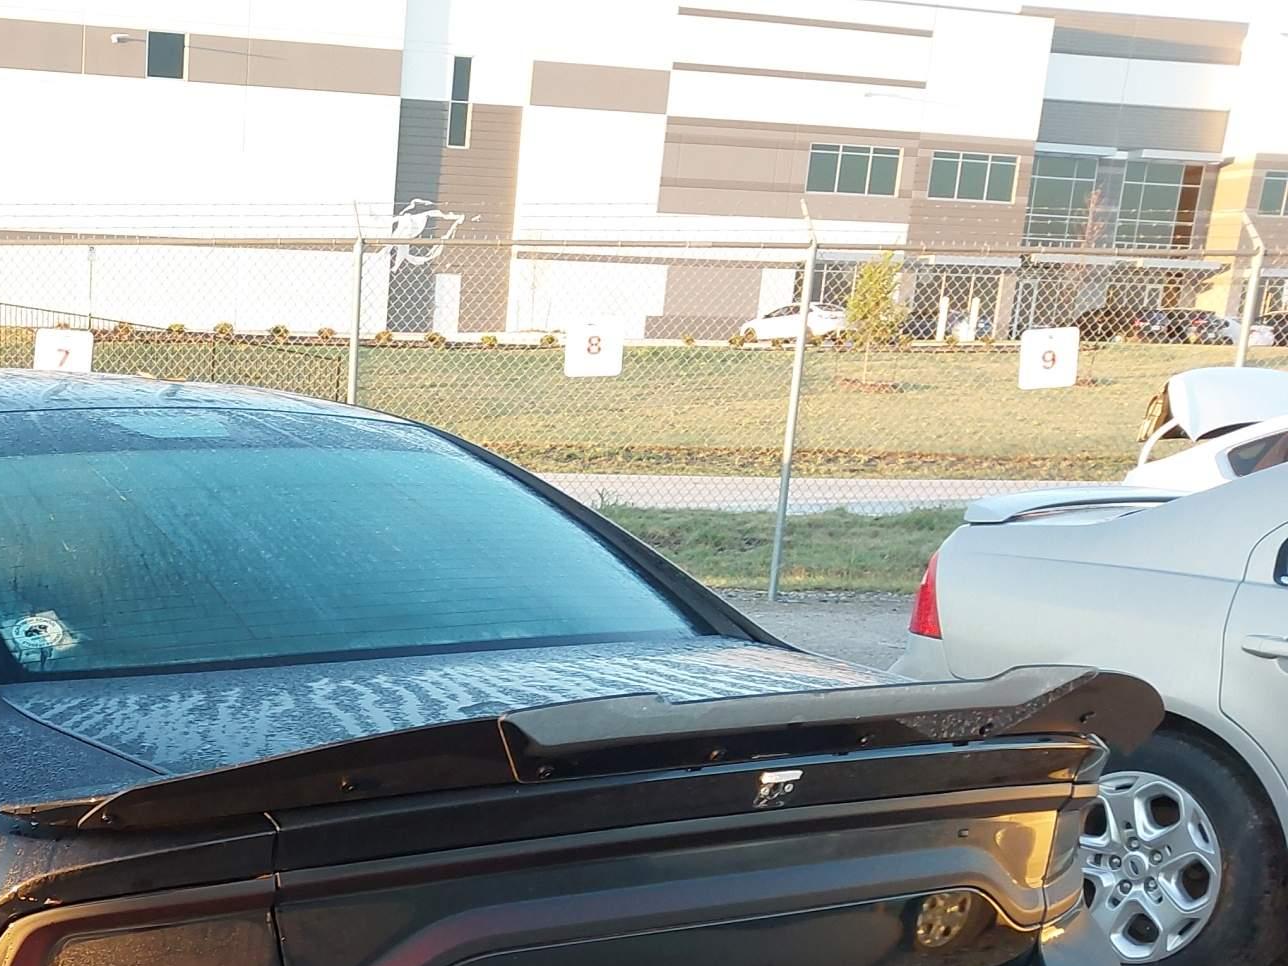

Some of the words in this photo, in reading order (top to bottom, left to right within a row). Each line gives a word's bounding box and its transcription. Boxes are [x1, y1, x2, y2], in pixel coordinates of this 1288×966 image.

[587, 335, 601, 355] 8
[57, 348, 70, 368] 7
[1041, 350, 1056, 370] 9
